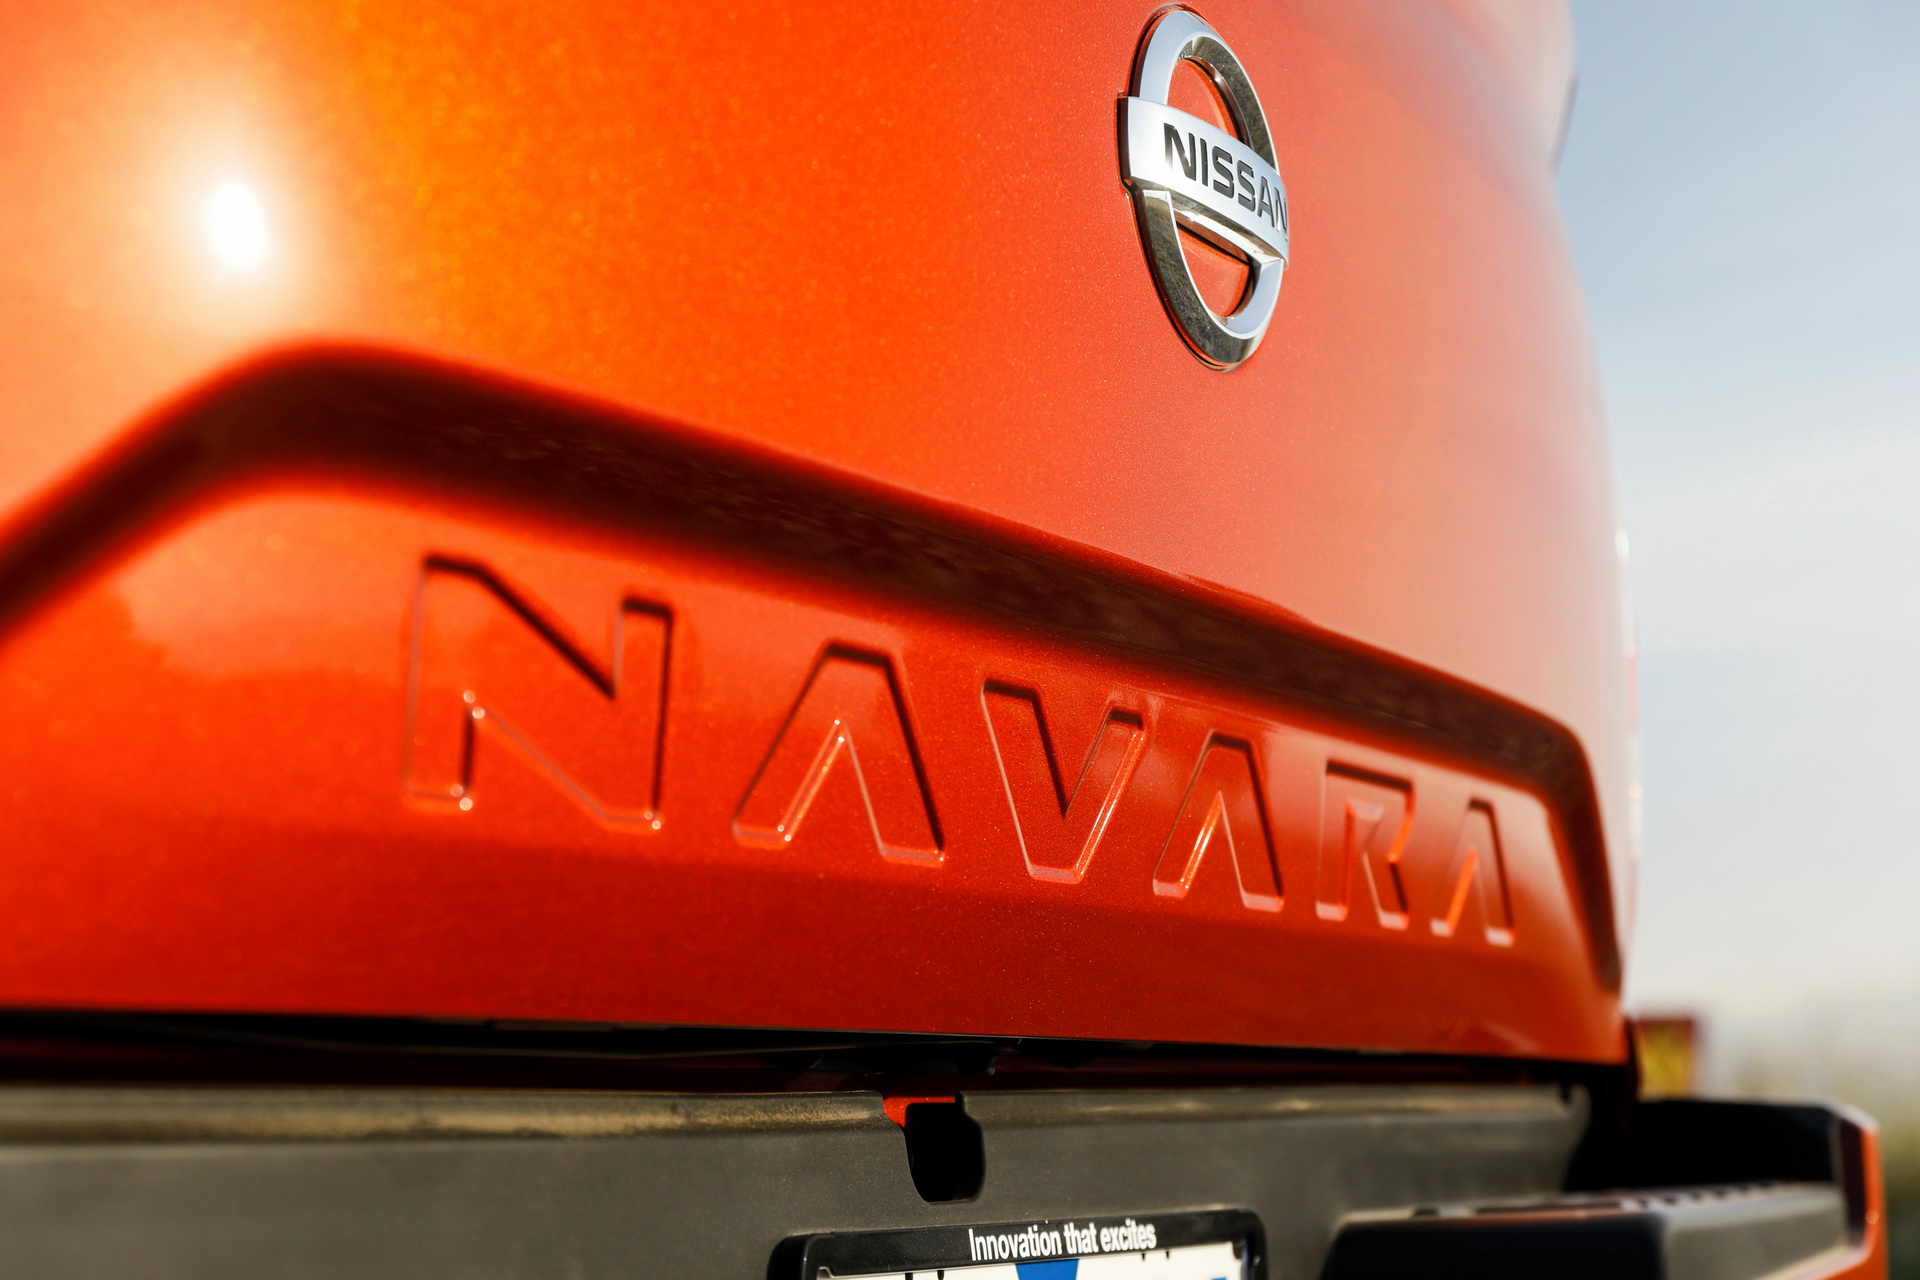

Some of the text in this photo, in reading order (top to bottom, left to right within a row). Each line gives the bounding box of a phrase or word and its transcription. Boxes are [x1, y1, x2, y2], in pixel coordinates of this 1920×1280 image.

[1164, 123, 1288, 240] NISSAN
[404, 553, 1514, 946] NAVARA
[968, 1218, 1156, 1261] Innovation that excites
